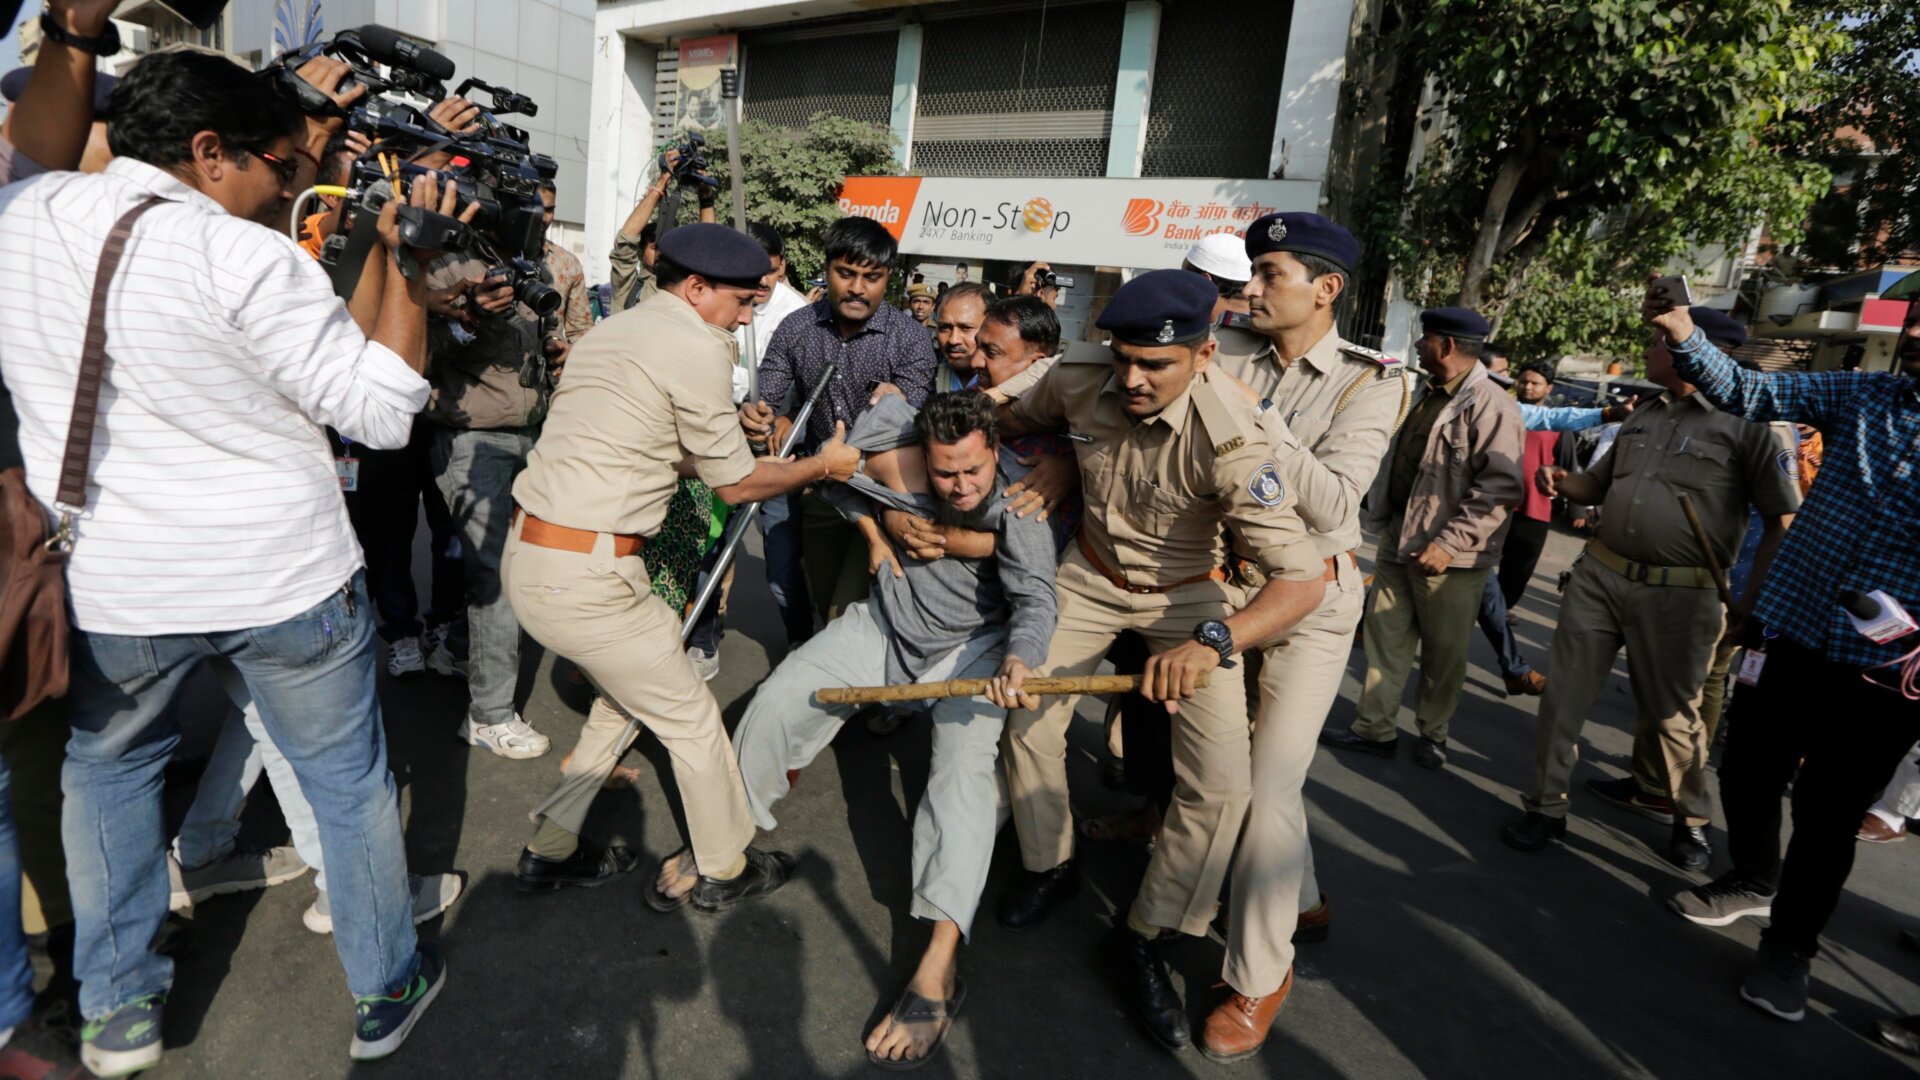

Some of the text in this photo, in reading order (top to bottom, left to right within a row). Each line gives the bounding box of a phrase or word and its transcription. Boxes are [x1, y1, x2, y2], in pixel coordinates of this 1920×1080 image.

[1166, 200, 1192, 219] बैंक
[919, 228, 993, 245] 24X7 Banking
[1164, 223, 1201, 240] Bank
[1164, 241, 1189, 250] India's
